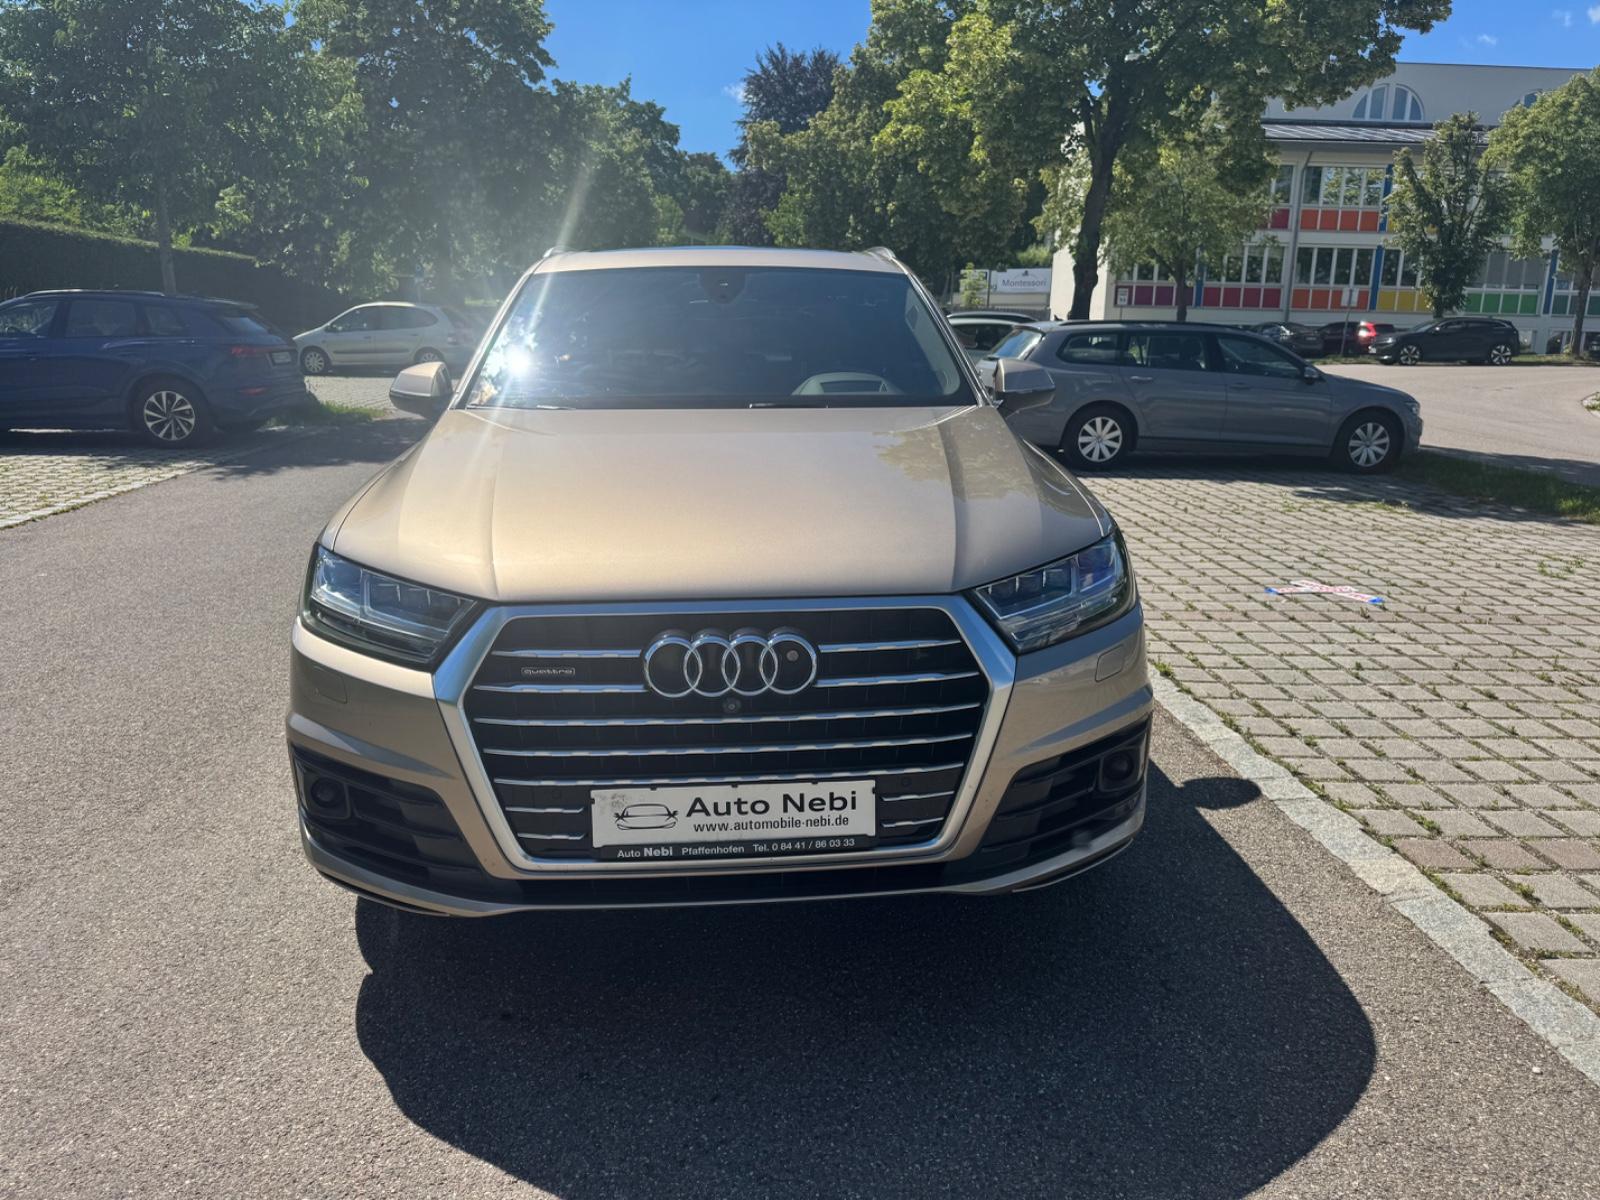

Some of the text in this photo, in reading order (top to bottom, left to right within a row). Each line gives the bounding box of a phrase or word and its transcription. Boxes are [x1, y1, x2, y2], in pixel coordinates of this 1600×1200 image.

[1002, 279, 1047, 288] Montessori
[685, 790, 857, 818] Auto Nebi
[693, 814, 849, 832] www.automobile-nebi.de
[617, 849, 641, 858] Auto
[643, 846, 673, 857] Nebi
[681, 844, 745, 856] Pfaffenhofen
[752, 843, 769, 853] Tel.
[772, 842, 779, 851] 0
[780, 842, 792, 850] 84
[794, 841, 806, 849] 41
[815, 840, 827, 849] 86
[829, 839, 841, 848] 03
[843, 838, 855, 847] 33
